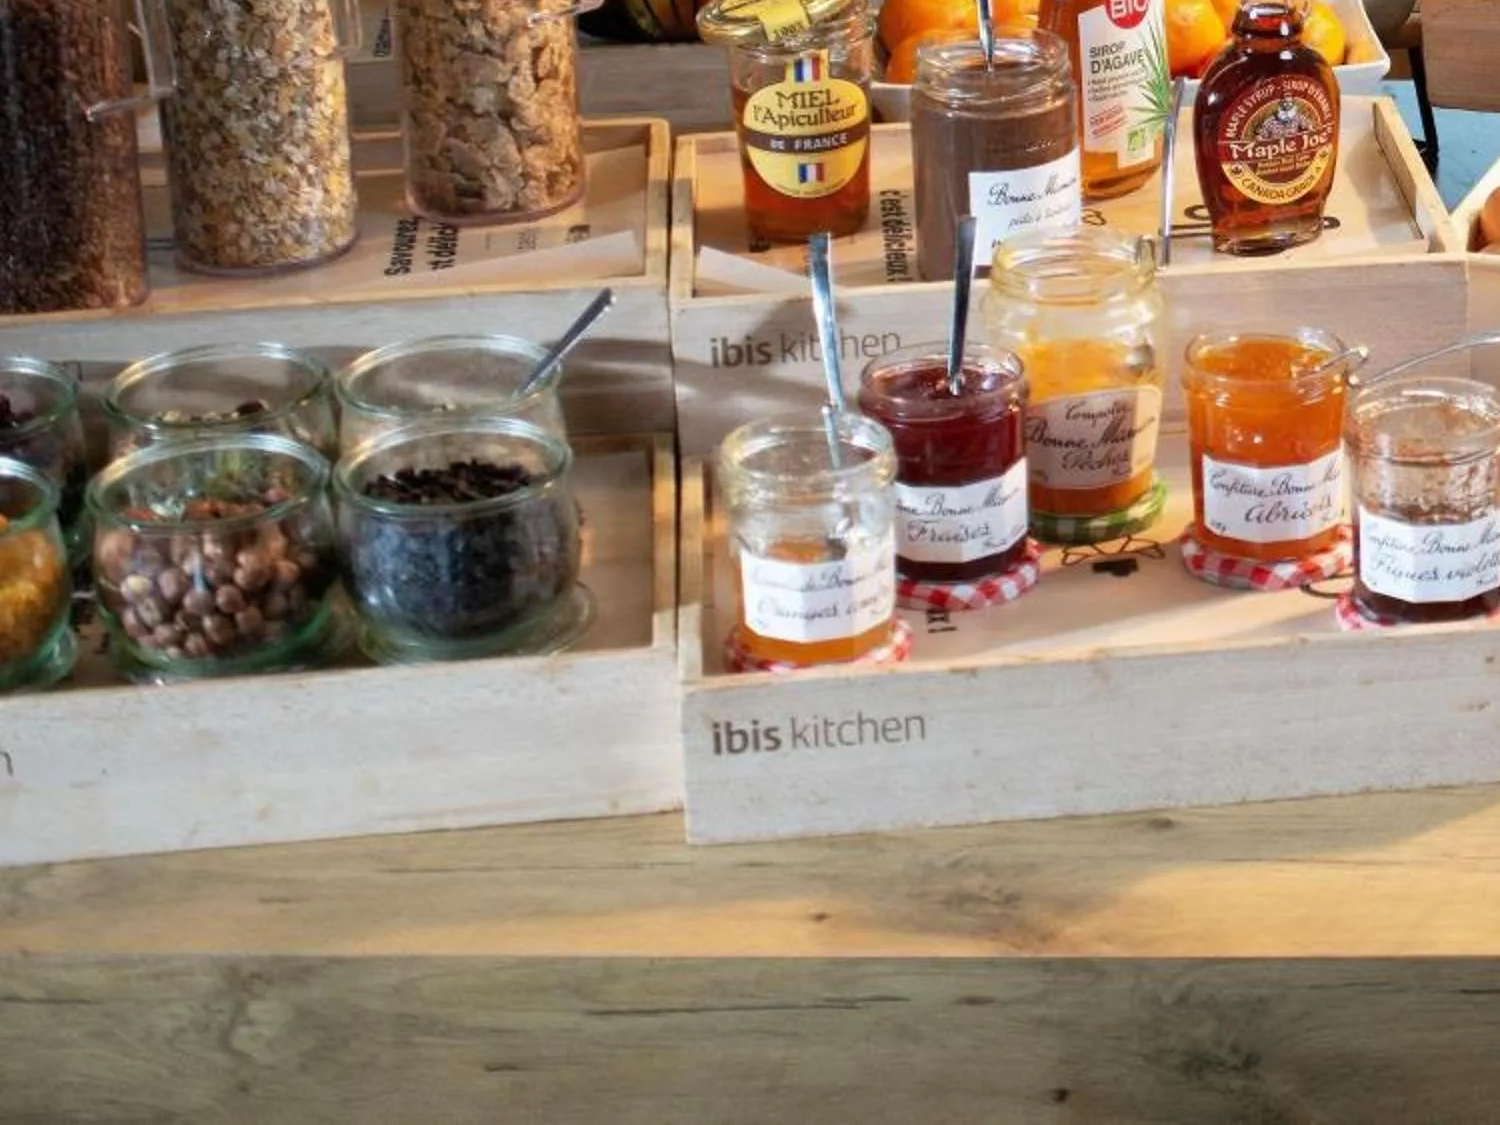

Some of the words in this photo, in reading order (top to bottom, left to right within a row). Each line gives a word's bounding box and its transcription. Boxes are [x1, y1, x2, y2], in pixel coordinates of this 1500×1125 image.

[1090, 49, 1145, 74] D'AGAVE
[776, 89, 840, 110] MIEL
[794, 133, 848, 150] FRANCE
[1229, 136, 1298, 160] Maple
[710, 336, 772, 369] ibis
[780, 327, 901, 364] kithen
[712, 719, 783, 756] ibis
[790, 710, 926, 749] kitchen
